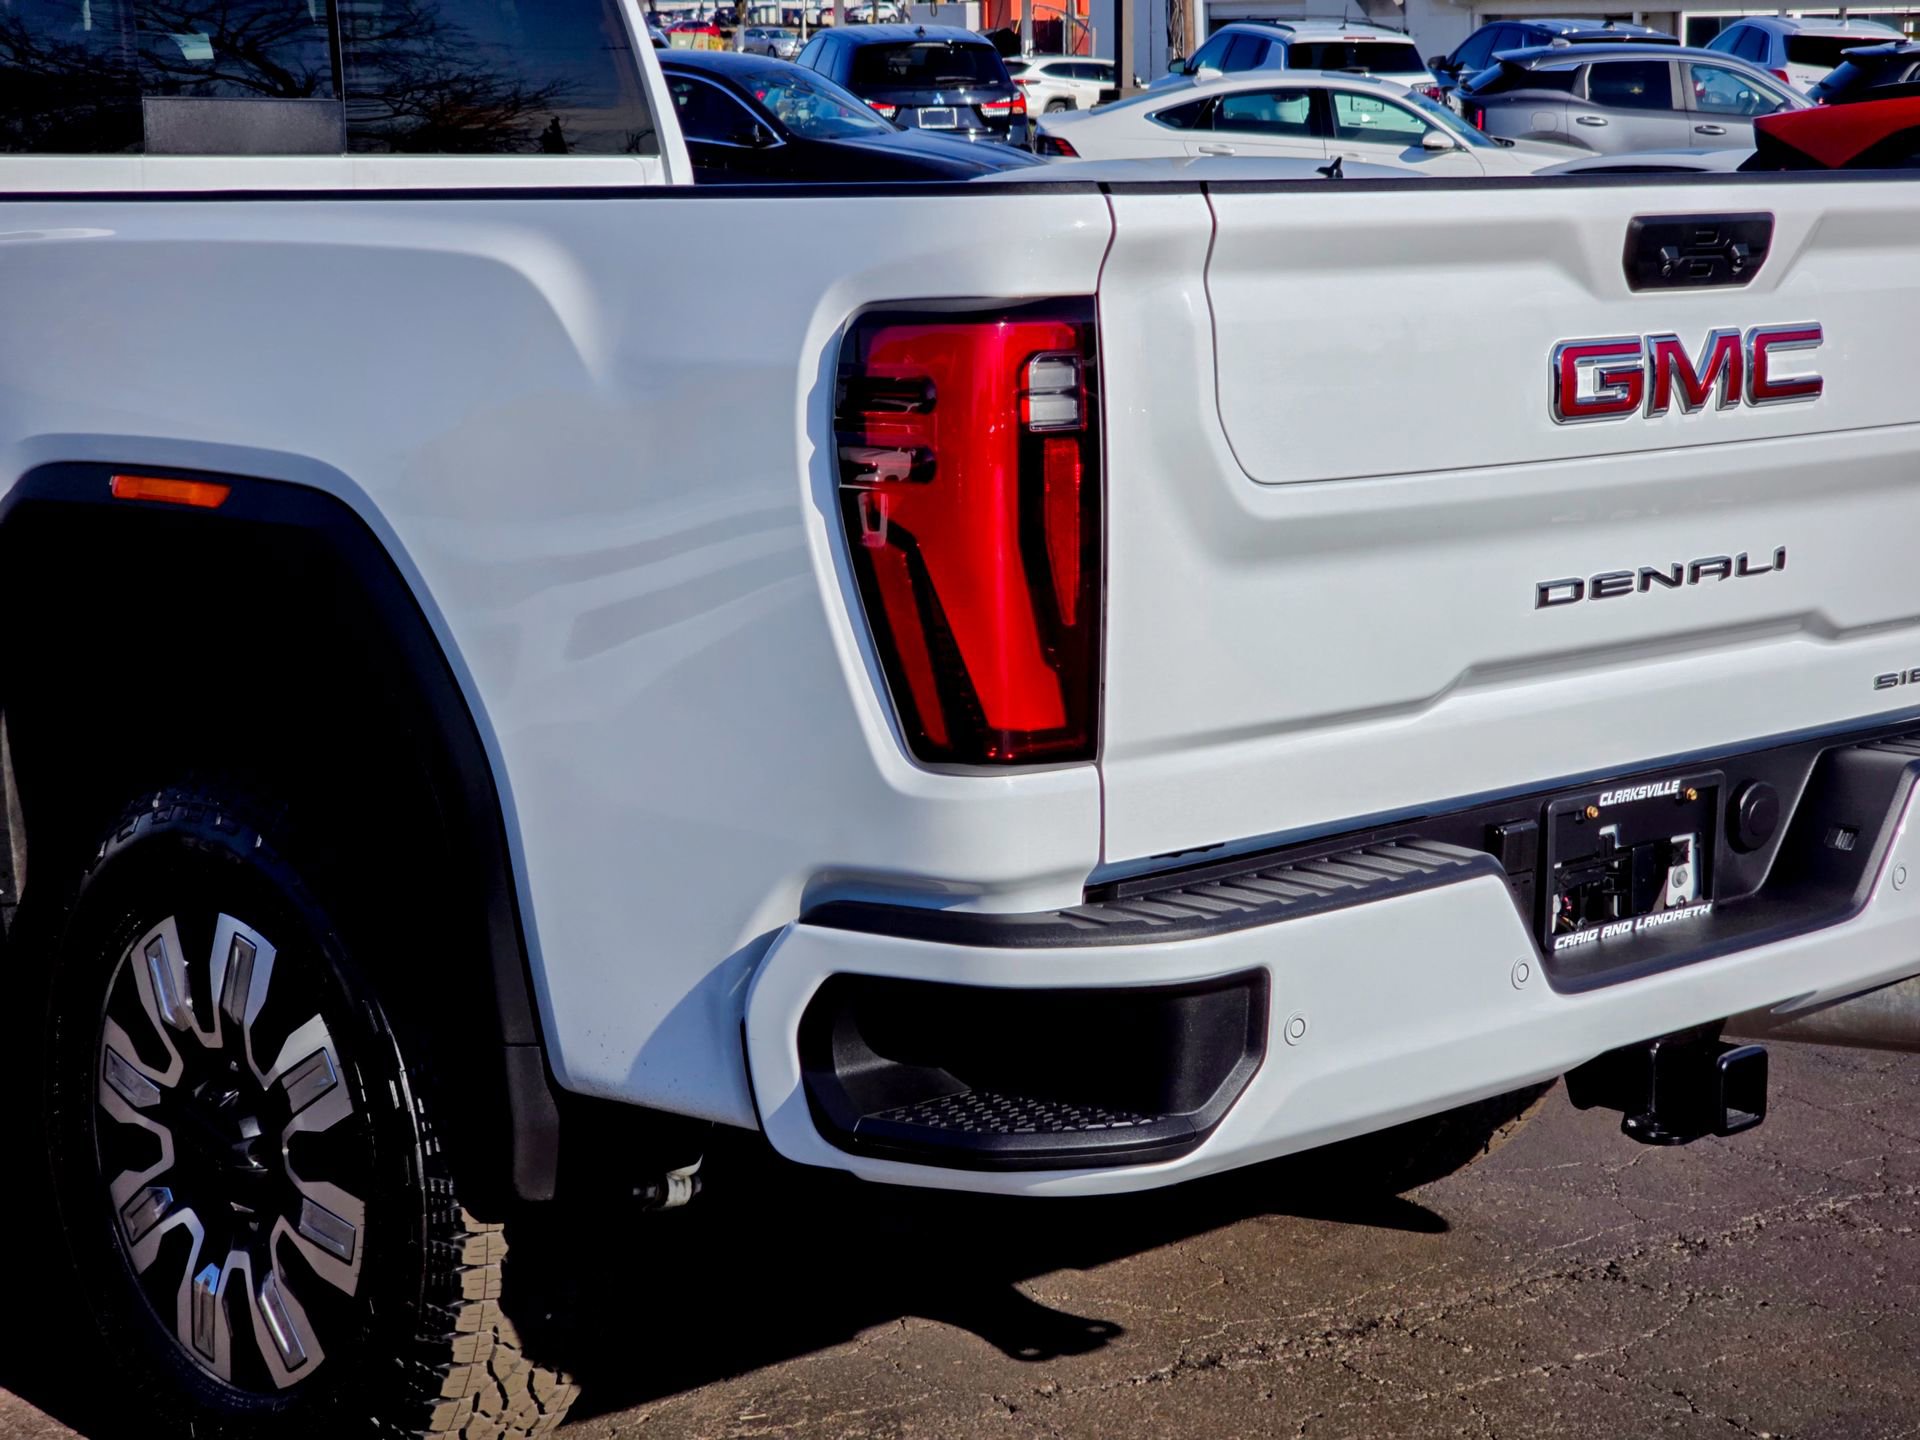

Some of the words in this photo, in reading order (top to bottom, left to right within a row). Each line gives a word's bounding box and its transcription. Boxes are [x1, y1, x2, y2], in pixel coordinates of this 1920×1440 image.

[1548, 320, 1824, 426] GMC
[1534, 545, 1786, 610] DENALI
[1599, 780, 1681, 807] CLARKSVILLE
[1554, 928, 1599, 950] CRAIG
[1601, 920, 1633, 939] AND
[1635, 903, 1713, 930] LANDRETH
